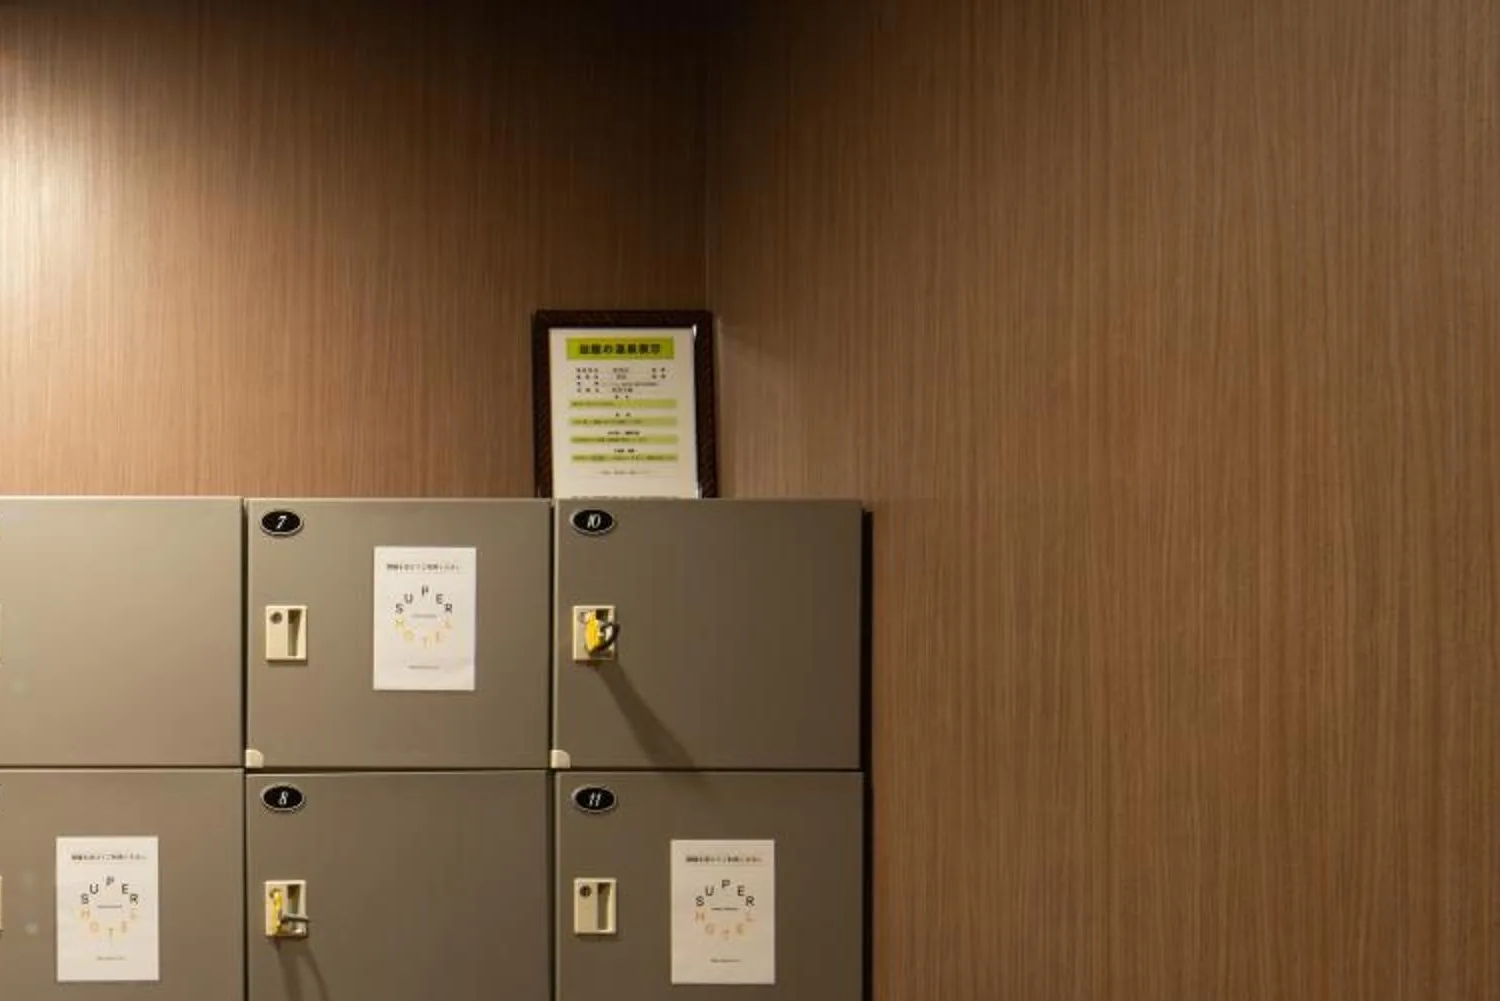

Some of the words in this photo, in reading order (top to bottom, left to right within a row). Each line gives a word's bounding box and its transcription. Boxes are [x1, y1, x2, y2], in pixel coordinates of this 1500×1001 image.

[276, 515, 286, 529] 7
[587, 513, 601, 528] 10
[394, 584, 453, 614] SUPER
[279, 790, 288, 805] 8
[589, 792, 601, 806] 11
[81, 876, 139, 905] SUPER
[696, 879, 755, 907] SUPER
